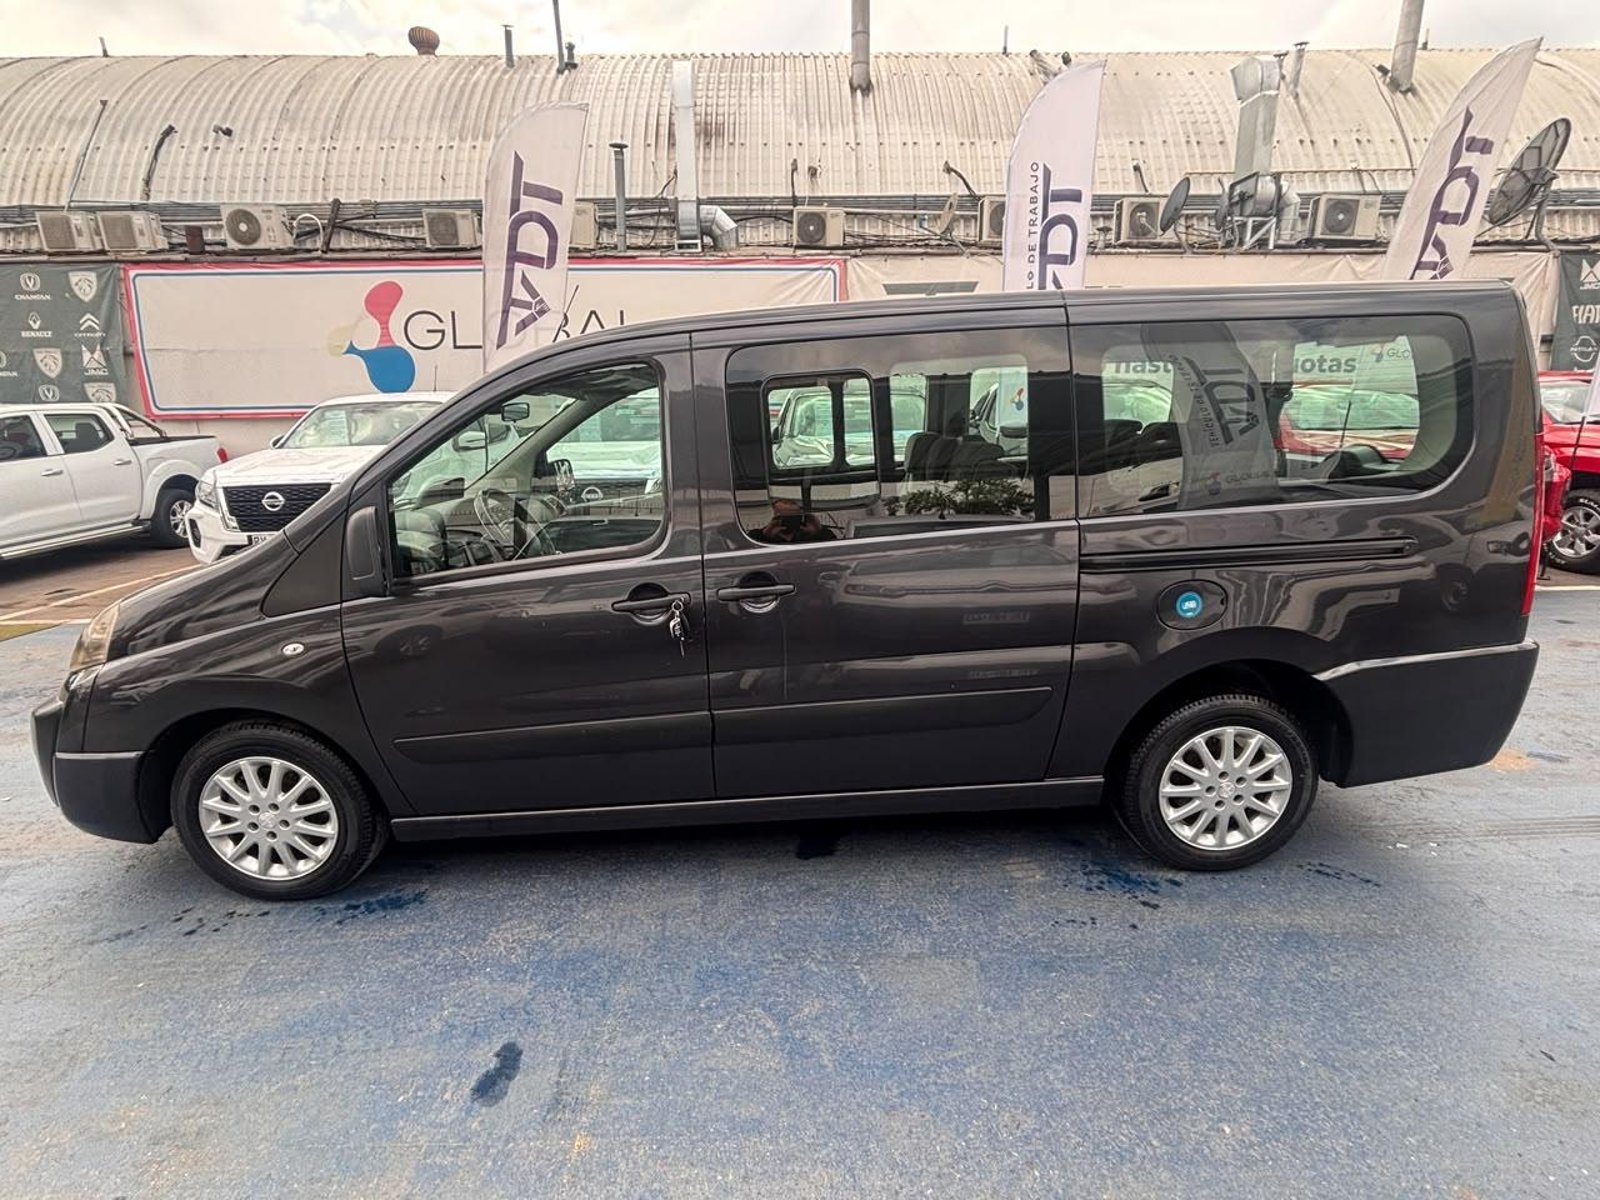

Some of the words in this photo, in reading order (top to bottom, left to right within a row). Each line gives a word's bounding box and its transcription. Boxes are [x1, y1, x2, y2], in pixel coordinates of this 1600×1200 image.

[1028, 161, 1040, 238] TRABAJO
[1038, 162, 1083, 290] DT
[1028, 245, 1037, 265] DE
[404, 309, 625, 351] GLBA
